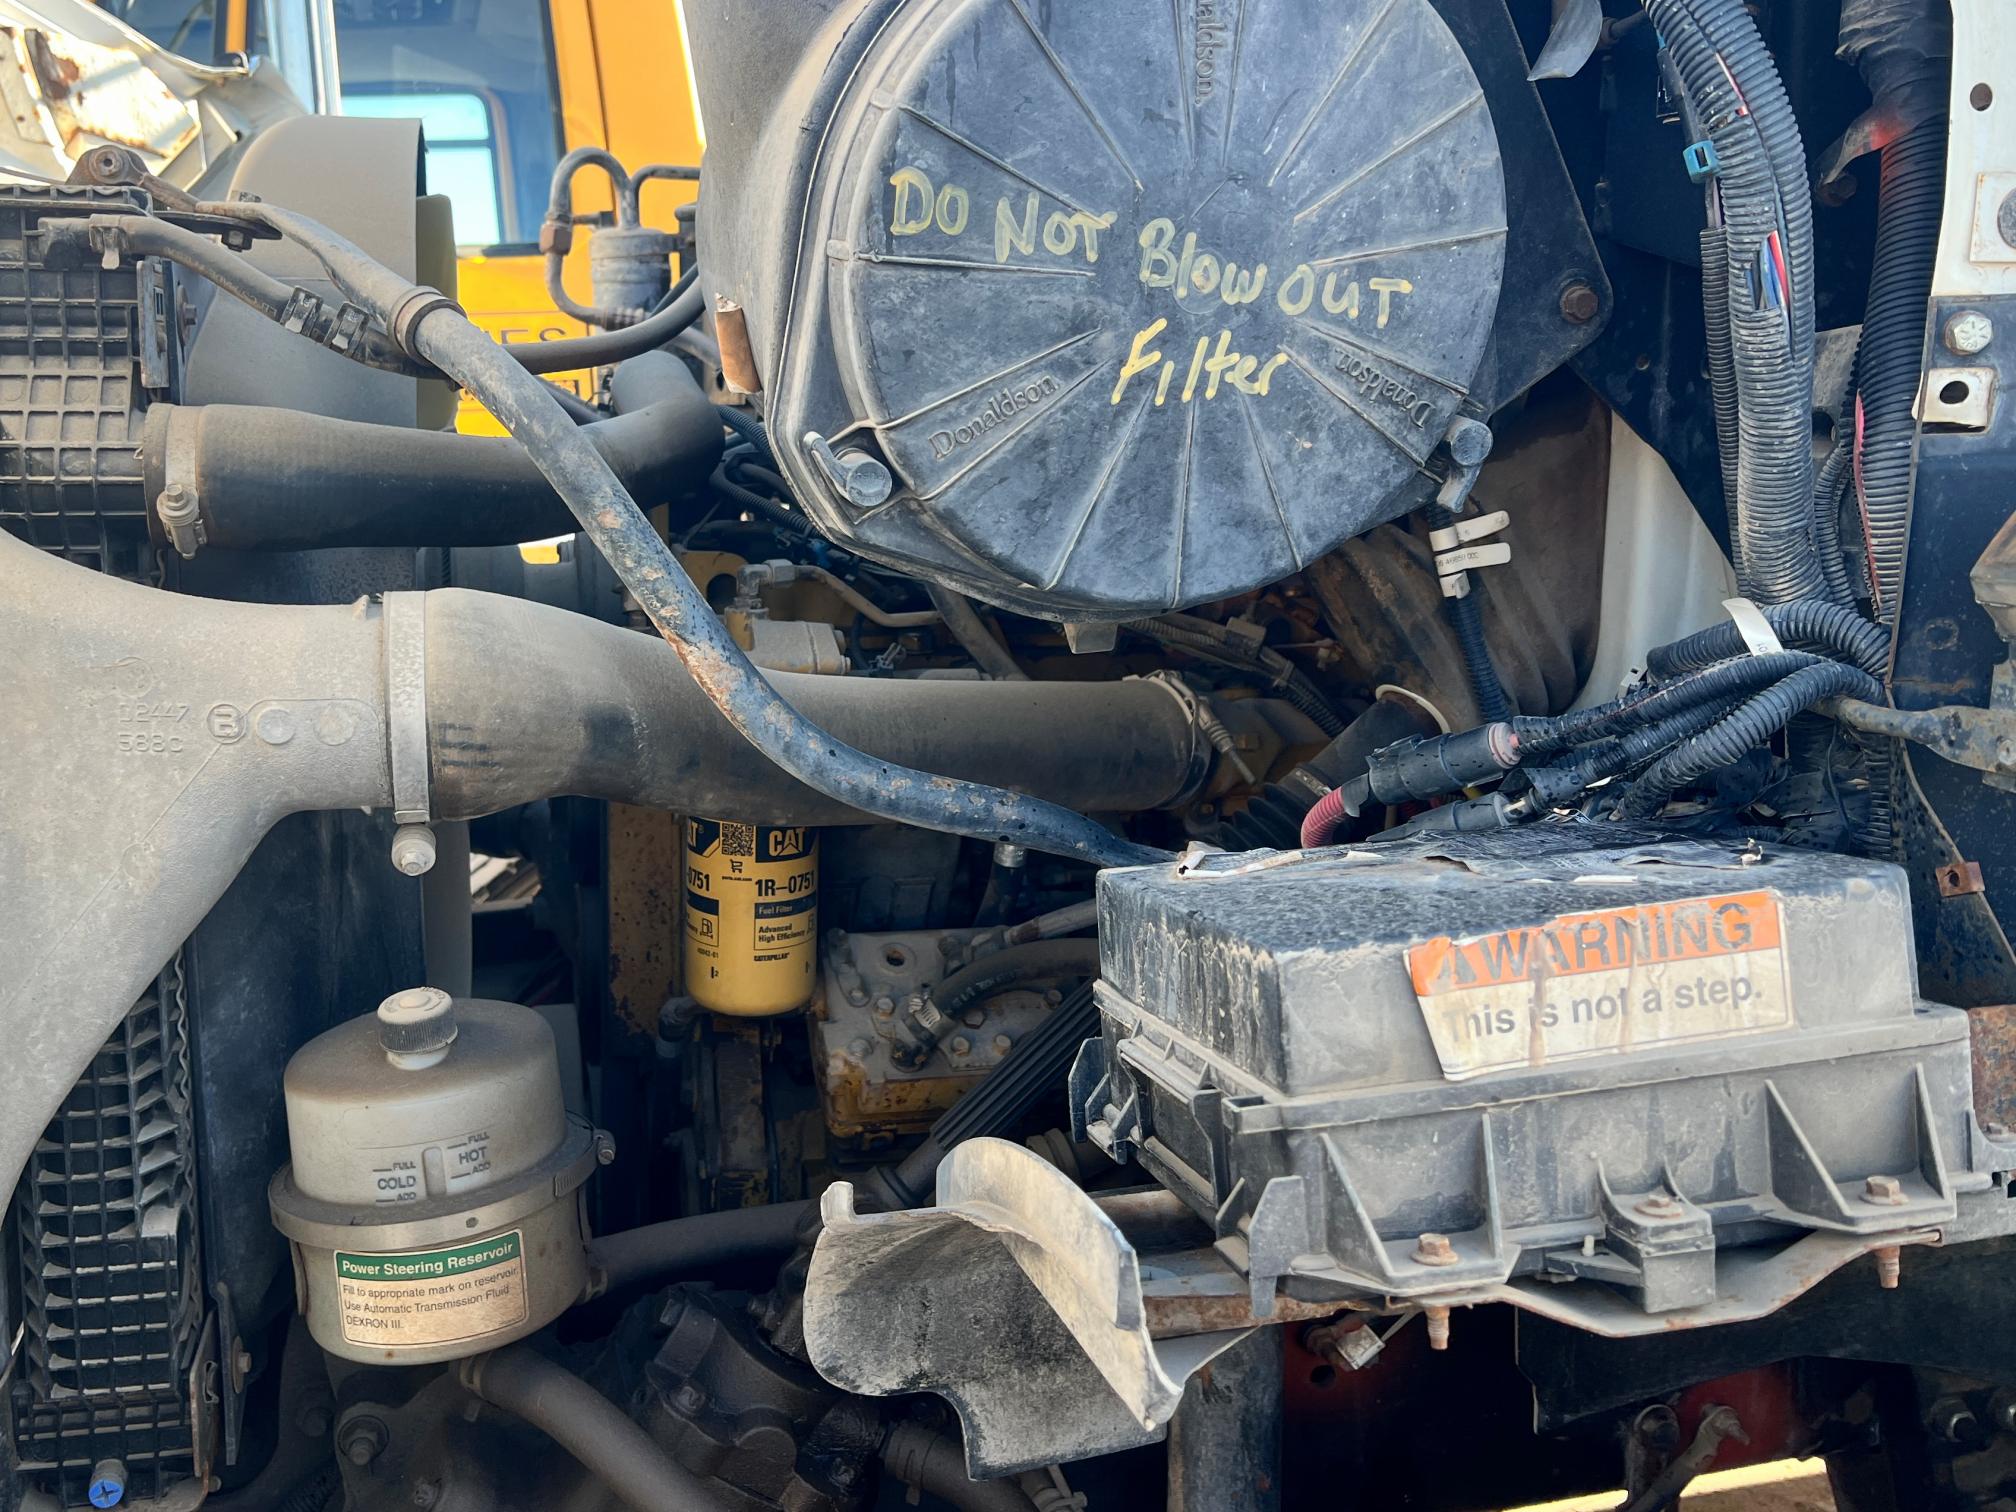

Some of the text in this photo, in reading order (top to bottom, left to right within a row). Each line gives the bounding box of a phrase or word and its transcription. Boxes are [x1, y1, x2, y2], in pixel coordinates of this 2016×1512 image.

[1110, 318, 1288, 406] Filter
[769, 826, 806, 857] CAT
[759, 905, 775, 915] Fuel
[759, 923, 792, 934] Advanced
[759, 934, 776, 944] High
[1479, 902, 1753, 980] WARNING
[1643, 993, 1662, 1013] a
[1674, 975, 1763, 1012] step.
[467, 1131, 490, 1144] FULL
[458, 1146, 488, 1165] HOT
[392, 1160, 417, 1172] FULL
[471, 1161, 491, 1174] ADD
[377, 1175, 417, 1190] COLD
[396, 1191, 417, 1202] ADD
[342, 1242, 514, 1276] Power Steering Reservoir
[343, 1284, 356, 1295] Fill
[357, 1286, 366, 1297] to
[368, 1287, 426, 1300] appropriate
[428, 1283, 455, 1296] mark
[458, 1280, 472, 1291] on
[344, 1302, 361, 1312] Use
[363, 1302, 412, 1314] Automatic
[414, 1295, 483, 1313] Transmission
[345, 1315, 388, 1329] DEXRON
